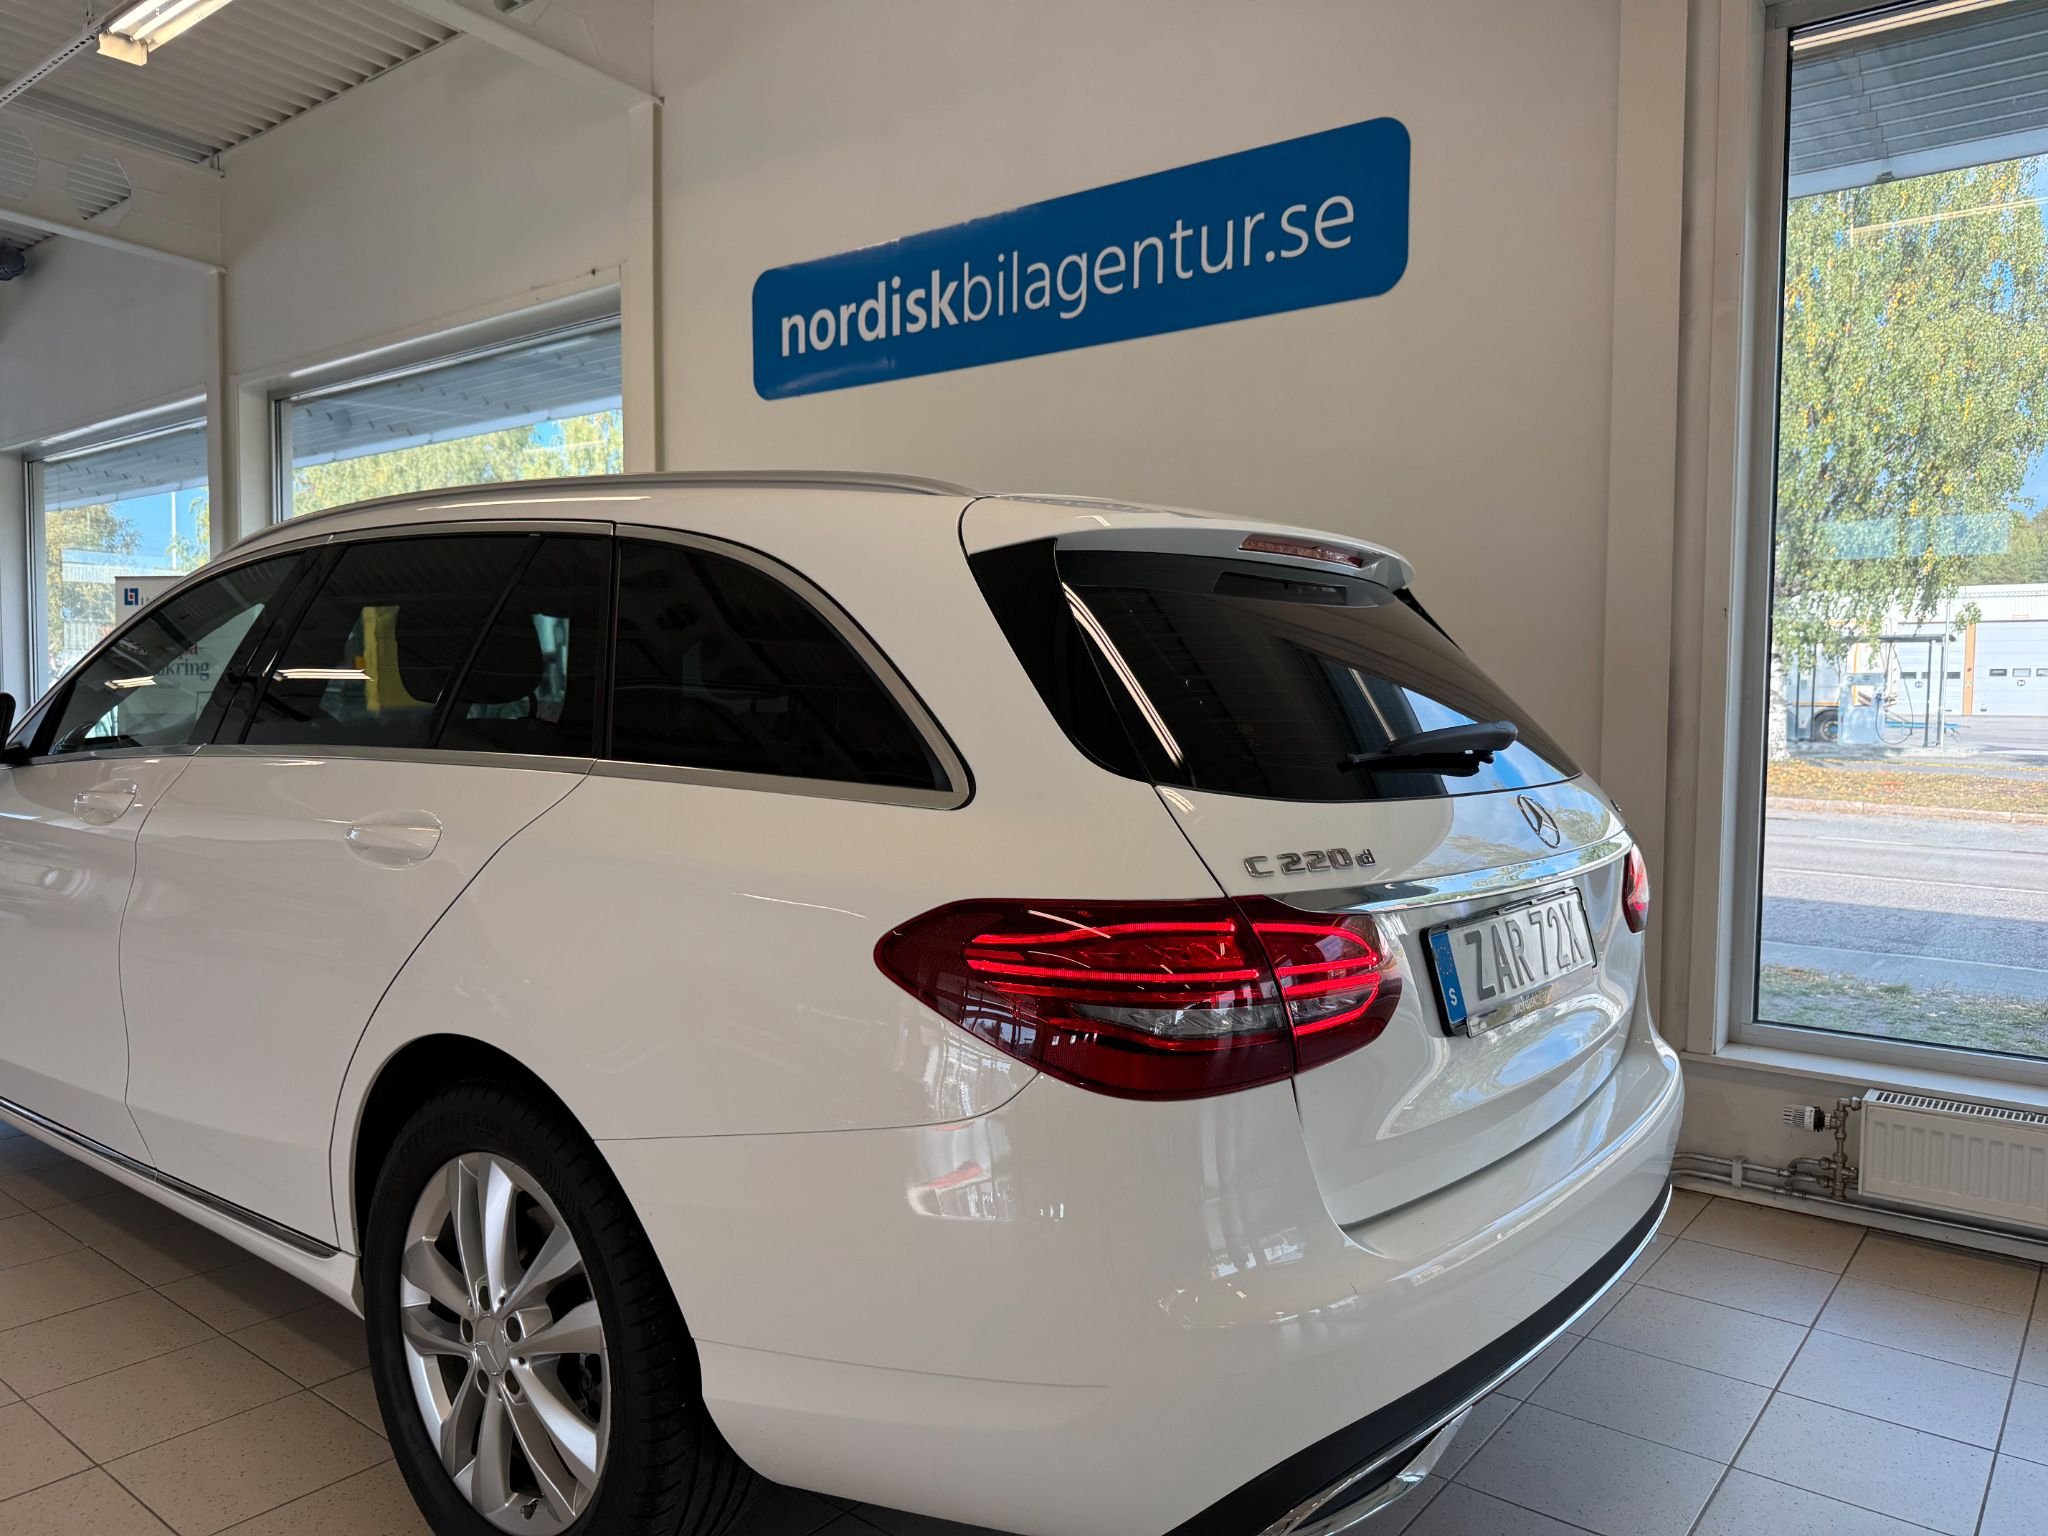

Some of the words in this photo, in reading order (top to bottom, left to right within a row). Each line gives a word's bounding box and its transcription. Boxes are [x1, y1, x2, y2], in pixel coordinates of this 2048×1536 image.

[781, 193, 1356, 358] nordiskbilagentur.se
[157, 658, 210, 681] kring
[1243, 855, 1275, 879] C
[1464, 918, 1535, 1001] ZAR
[1528, 900, 1584, 977] 72X
[1448, 987, 1459, 1006] S
